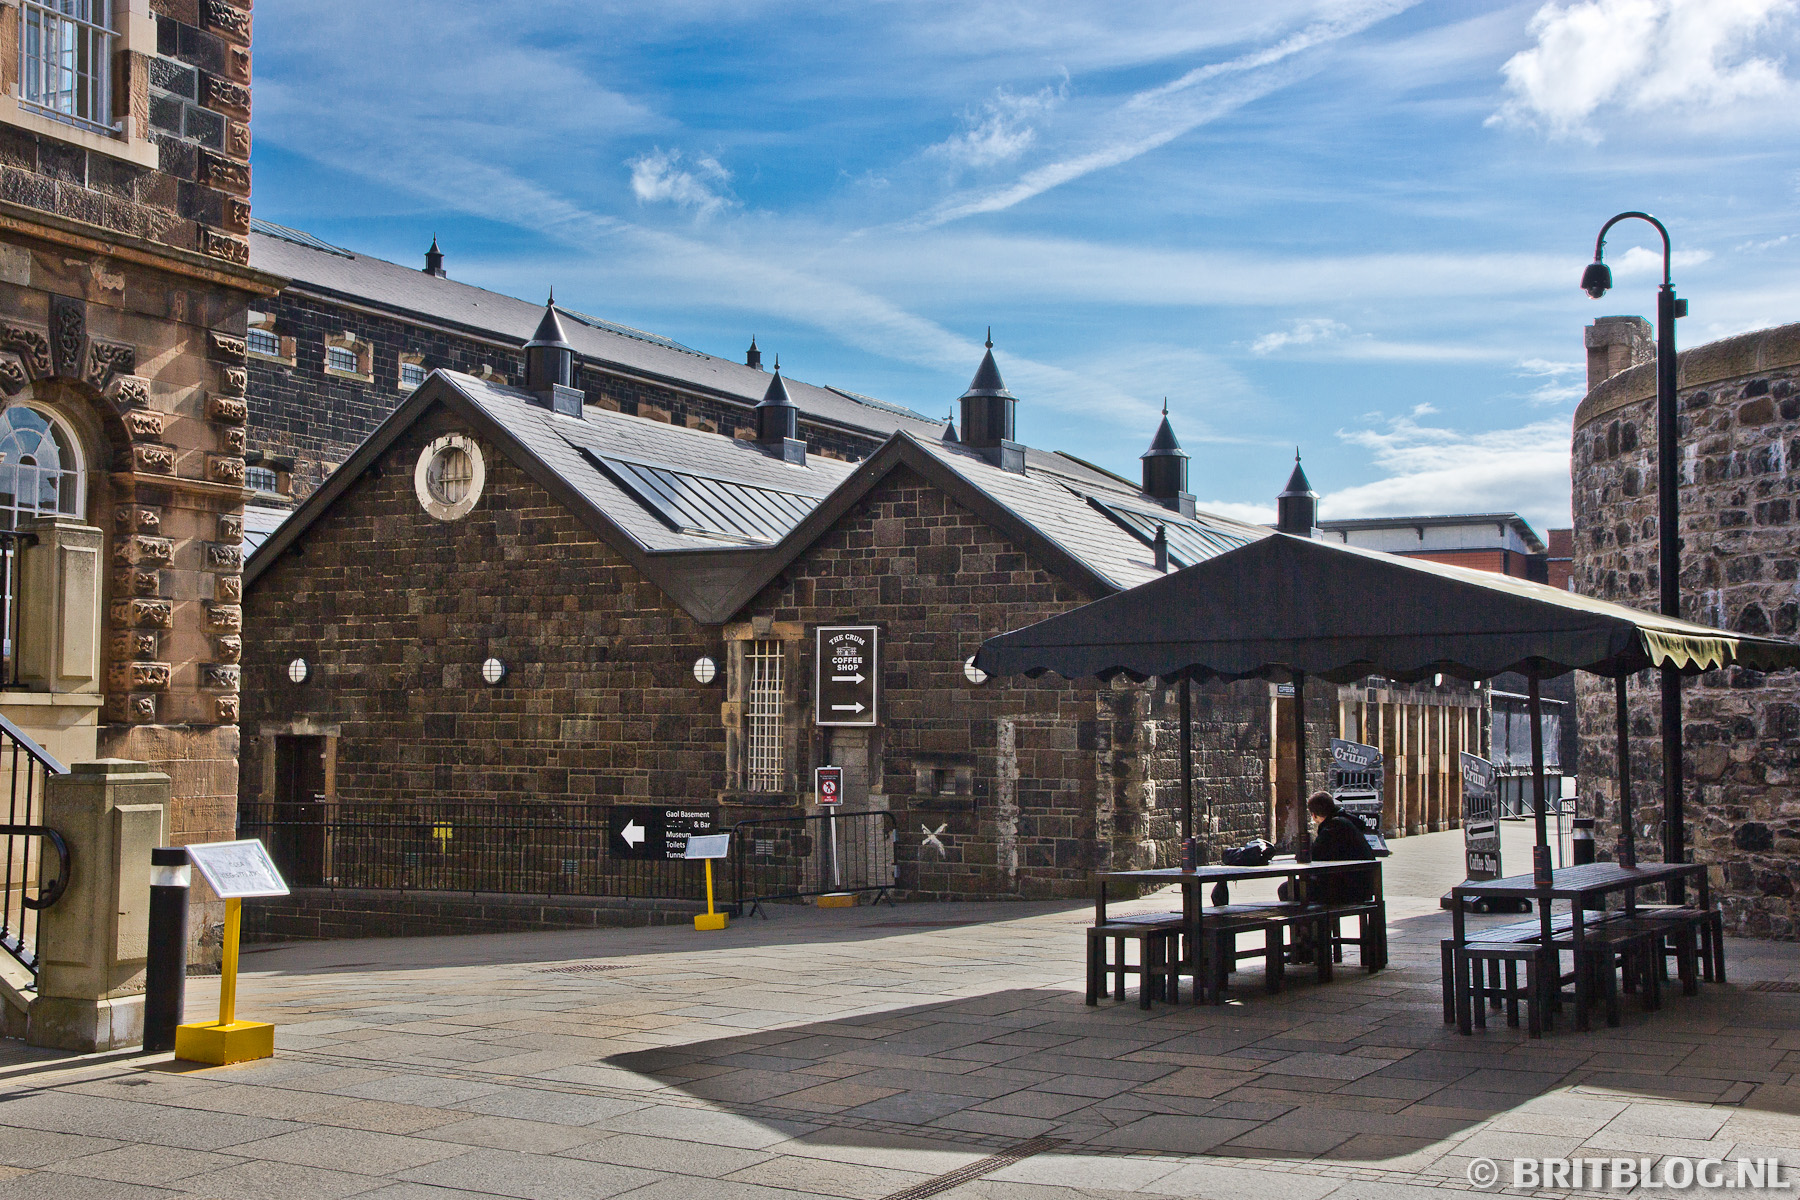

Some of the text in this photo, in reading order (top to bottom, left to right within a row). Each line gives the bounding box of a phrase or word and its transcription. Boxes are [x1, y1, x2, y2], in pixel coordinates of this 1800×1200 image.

[828, 633, 866, 646] THE CRUM
[1347, 744, 1360, 754] The
[1334, 747, 1368, 766] Crum
[1471, 760, 1479, 773] The
[1463, 764, 1486, 788] Crum
[665, 810, 710, 818] Gaol Basement
[1469, 853, 1497, 877] Coffee Shop
